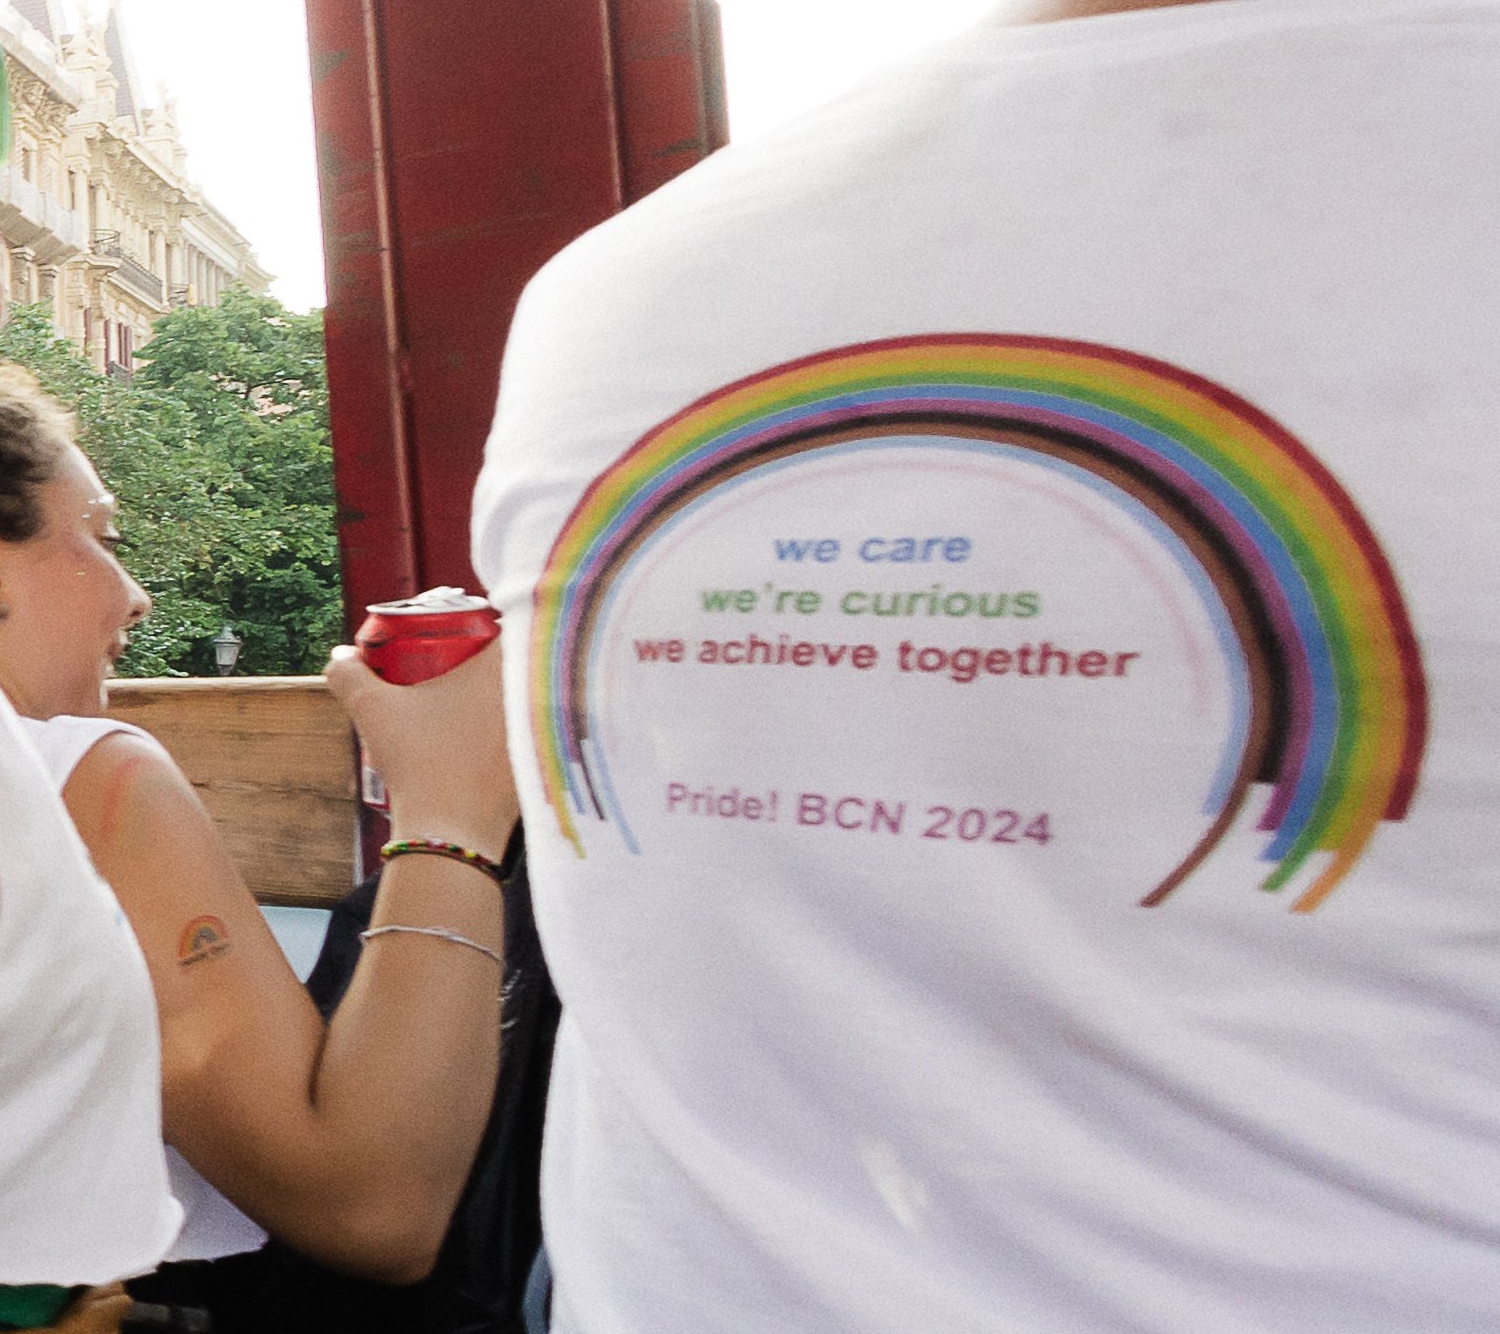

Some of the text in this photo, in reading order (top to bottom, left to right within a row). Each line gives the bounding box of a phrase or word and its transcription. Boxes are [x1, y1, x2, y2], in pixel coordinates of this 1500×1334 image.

[773, 536, 972, 563] we care
[701, 581, 1041, 618] we're curious
[633, 633, 1141, 684] we achieve together
[665, 781, 1053, 846] Pride! BCN 2024
